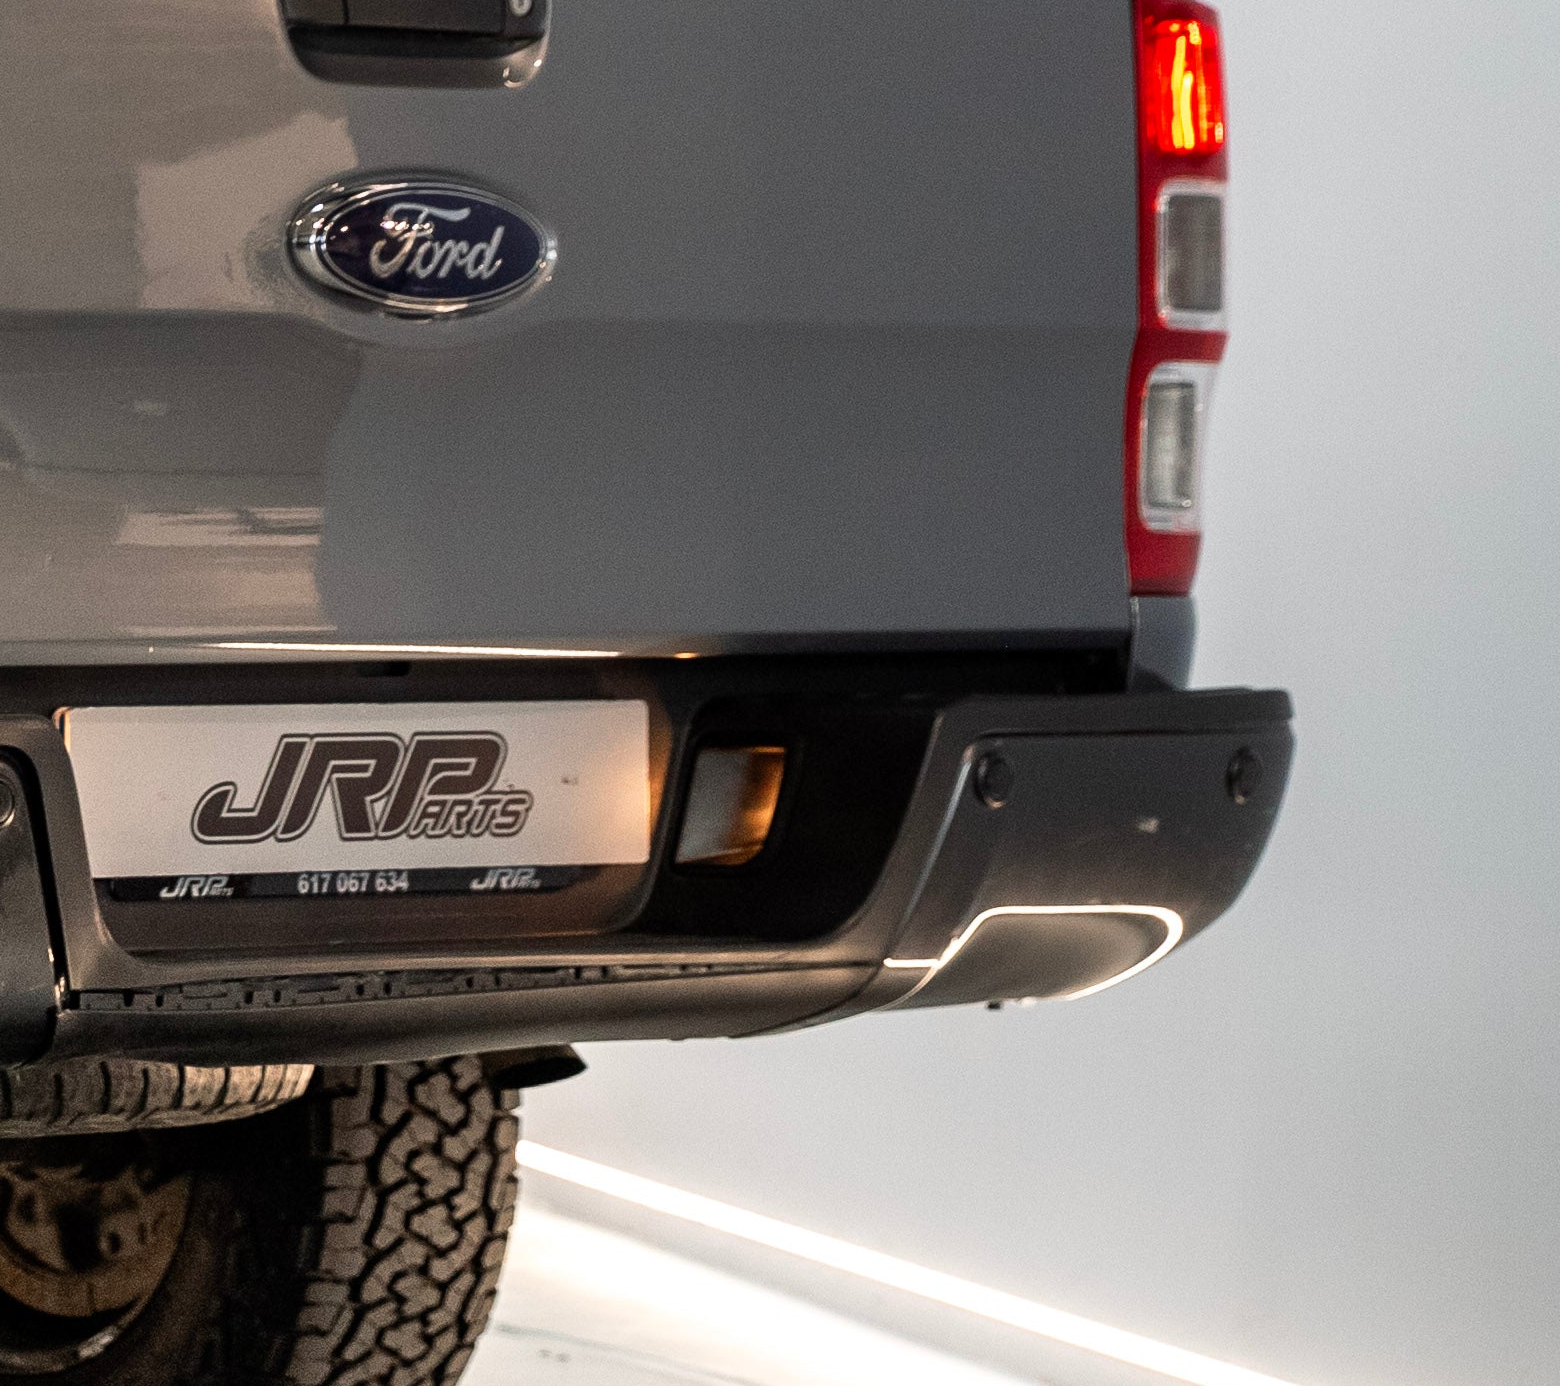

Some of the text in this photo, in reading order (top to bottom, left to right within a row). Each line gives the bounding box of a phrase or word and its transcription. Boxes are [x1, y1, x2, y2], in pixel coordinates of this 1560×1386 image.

[369, 202, 505, 279] Ford
[191, 730, 508, 844] JRP
[297, 870, 410, 894] 617 067 634
